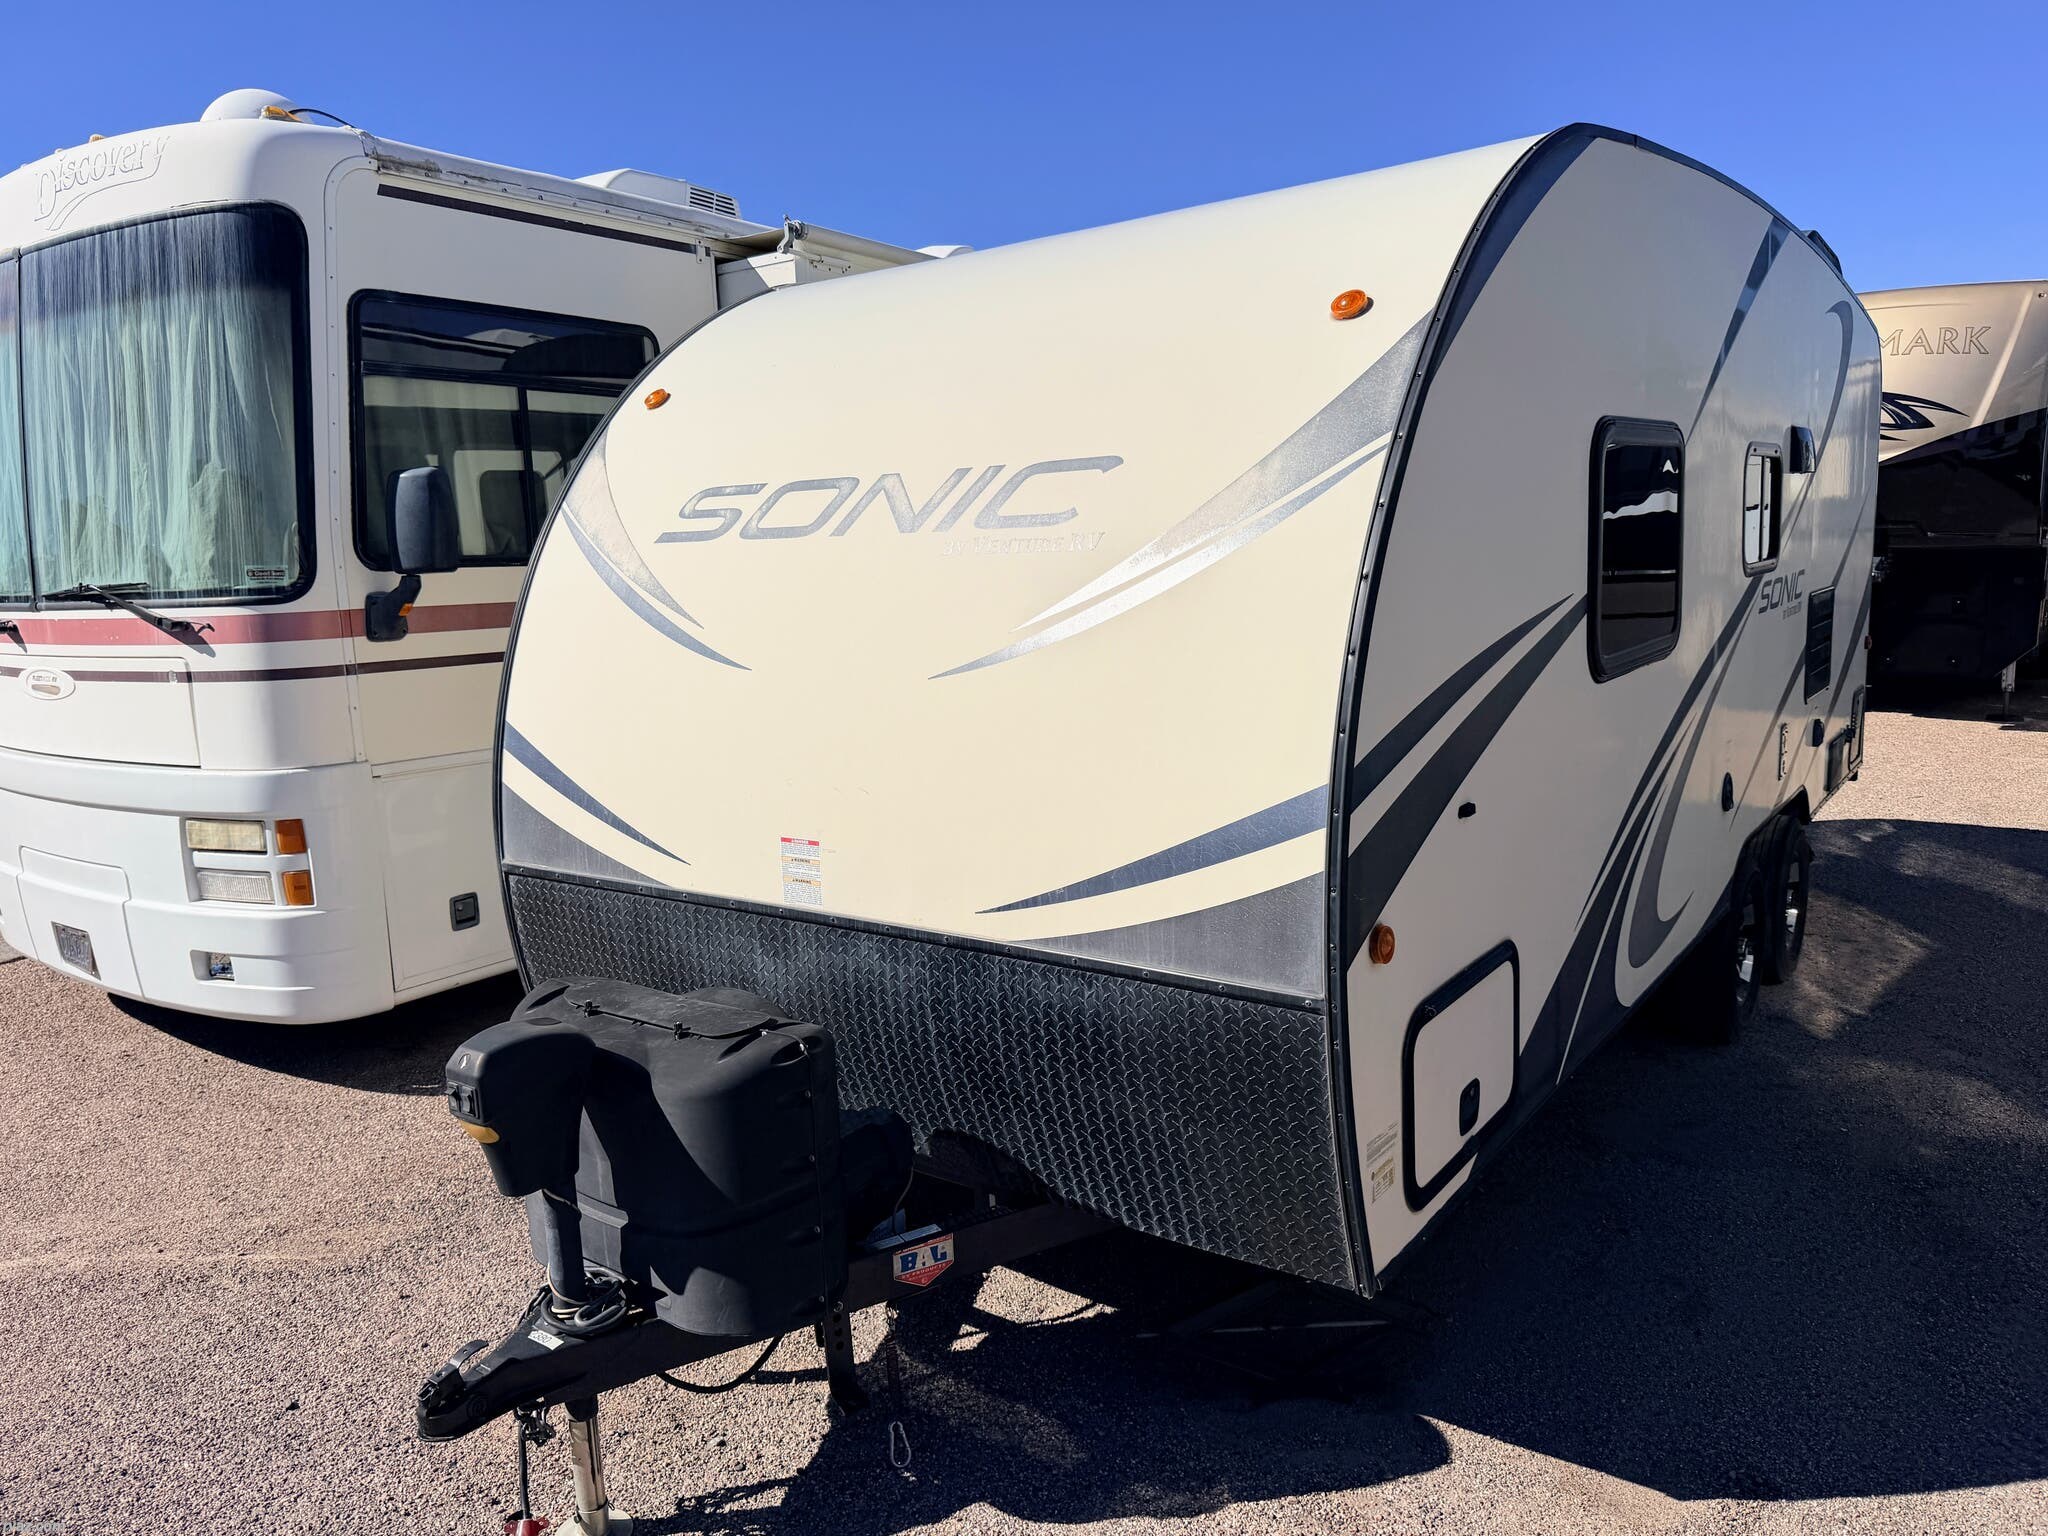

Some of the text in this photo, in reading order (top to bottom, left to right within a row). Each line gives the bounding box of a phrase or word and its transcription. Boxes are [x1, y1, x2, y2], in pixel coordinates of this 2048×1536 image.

[33, 136, 171, 223] Discovery
[653, 455, 1124, 544] SONIC
[1069, 531, 1106, 552] RV
[1758, 569, 1806, 614] SONIC
[900, 1244, 947, 1273] BAL
